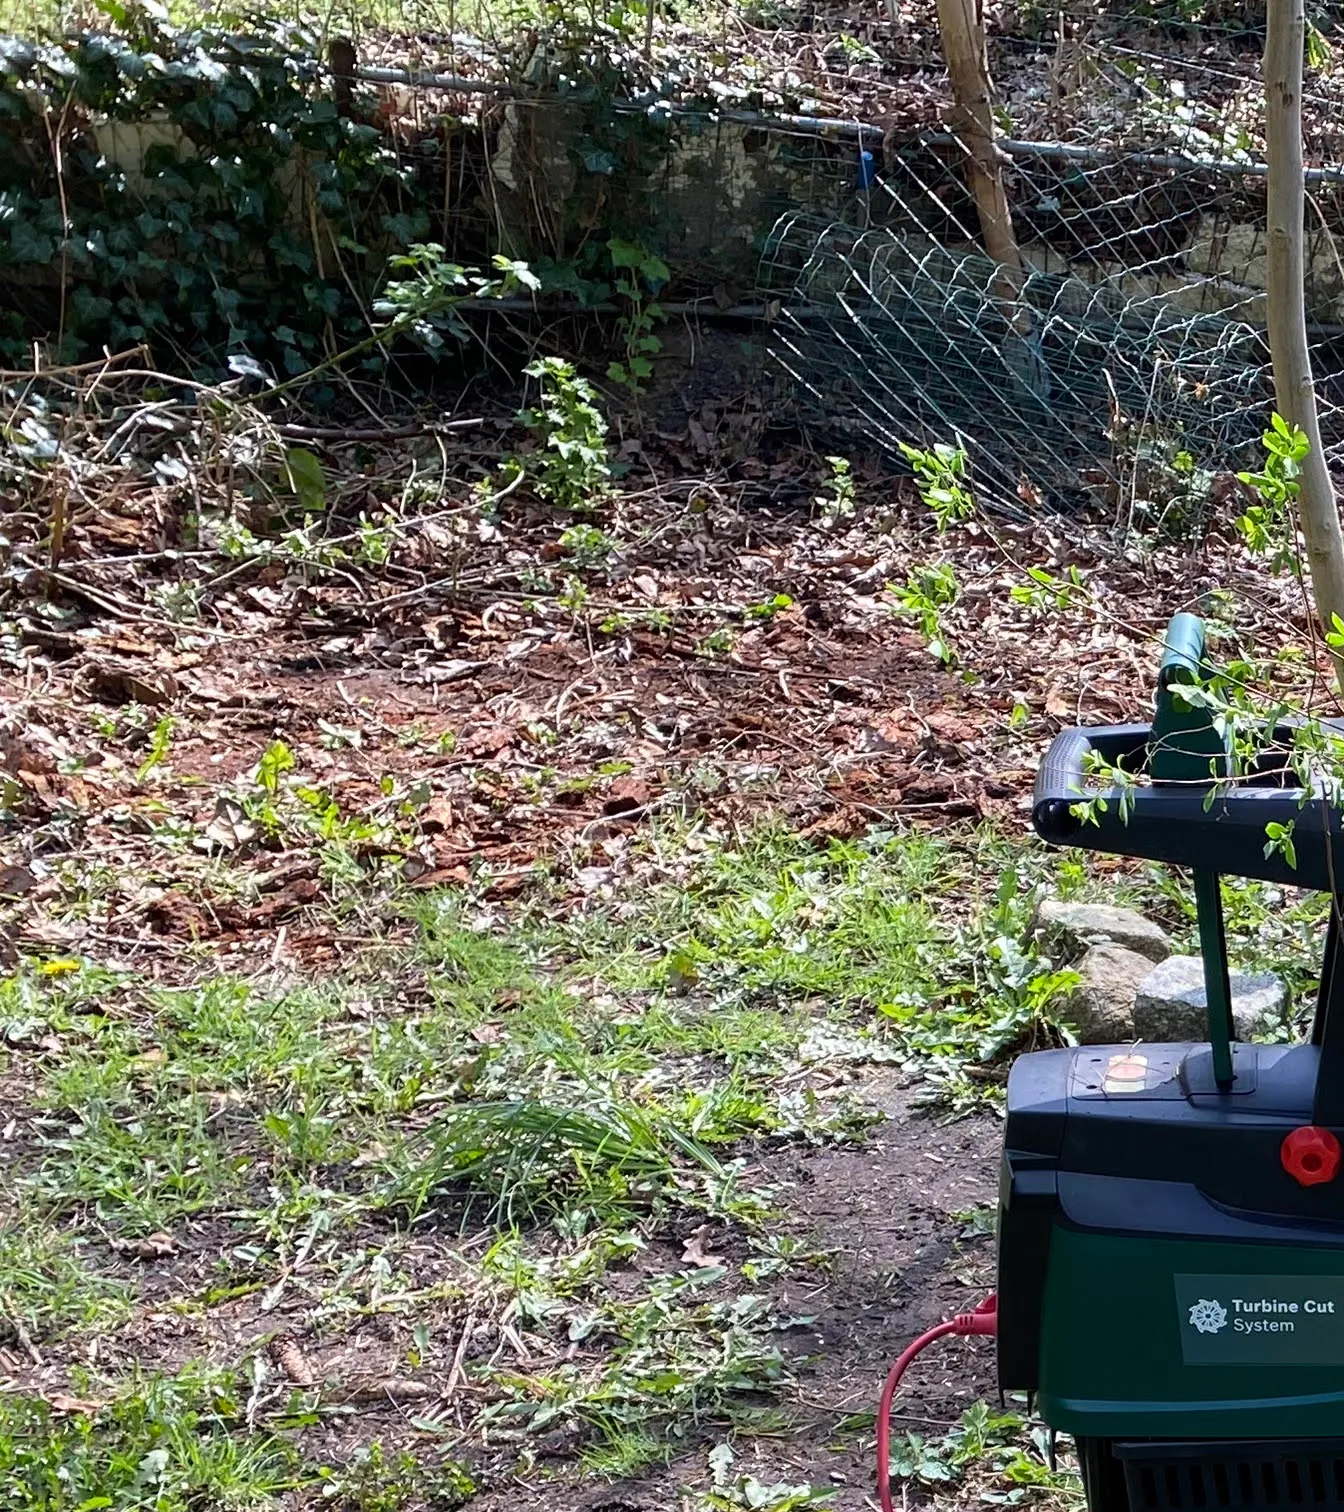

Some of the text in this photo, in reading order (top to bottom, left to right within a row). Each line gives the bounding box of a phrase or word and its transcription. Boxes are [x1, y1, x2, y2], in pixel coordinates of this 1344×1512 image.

[1232, 1299, 1335, 1313] Turbine Cut
[1233, 1318, 1295, 1334] System
